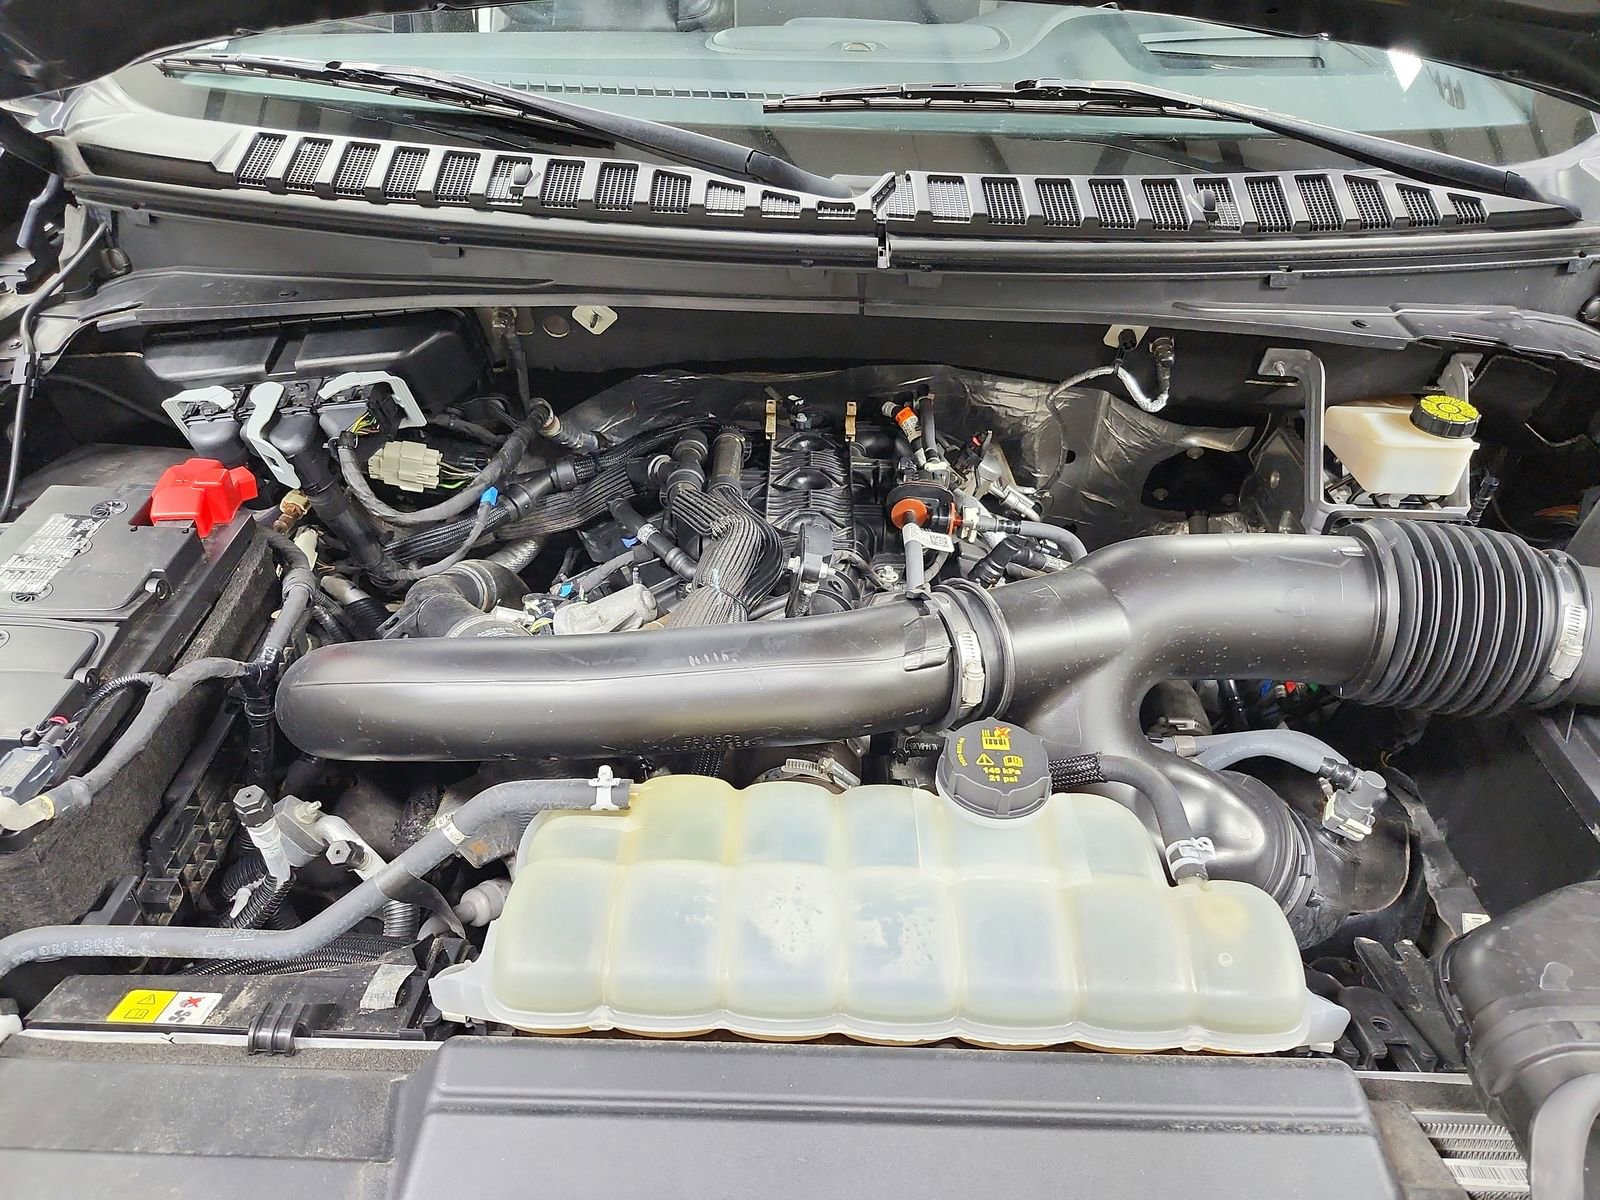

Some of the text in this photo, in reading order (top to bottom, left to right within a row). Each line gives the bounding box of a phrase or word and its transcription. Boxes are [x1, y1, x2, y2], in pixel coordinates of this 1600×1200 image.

[1001, 767, 1021, 775] kPa
[988, 774, 1018, 784] 21 psi
